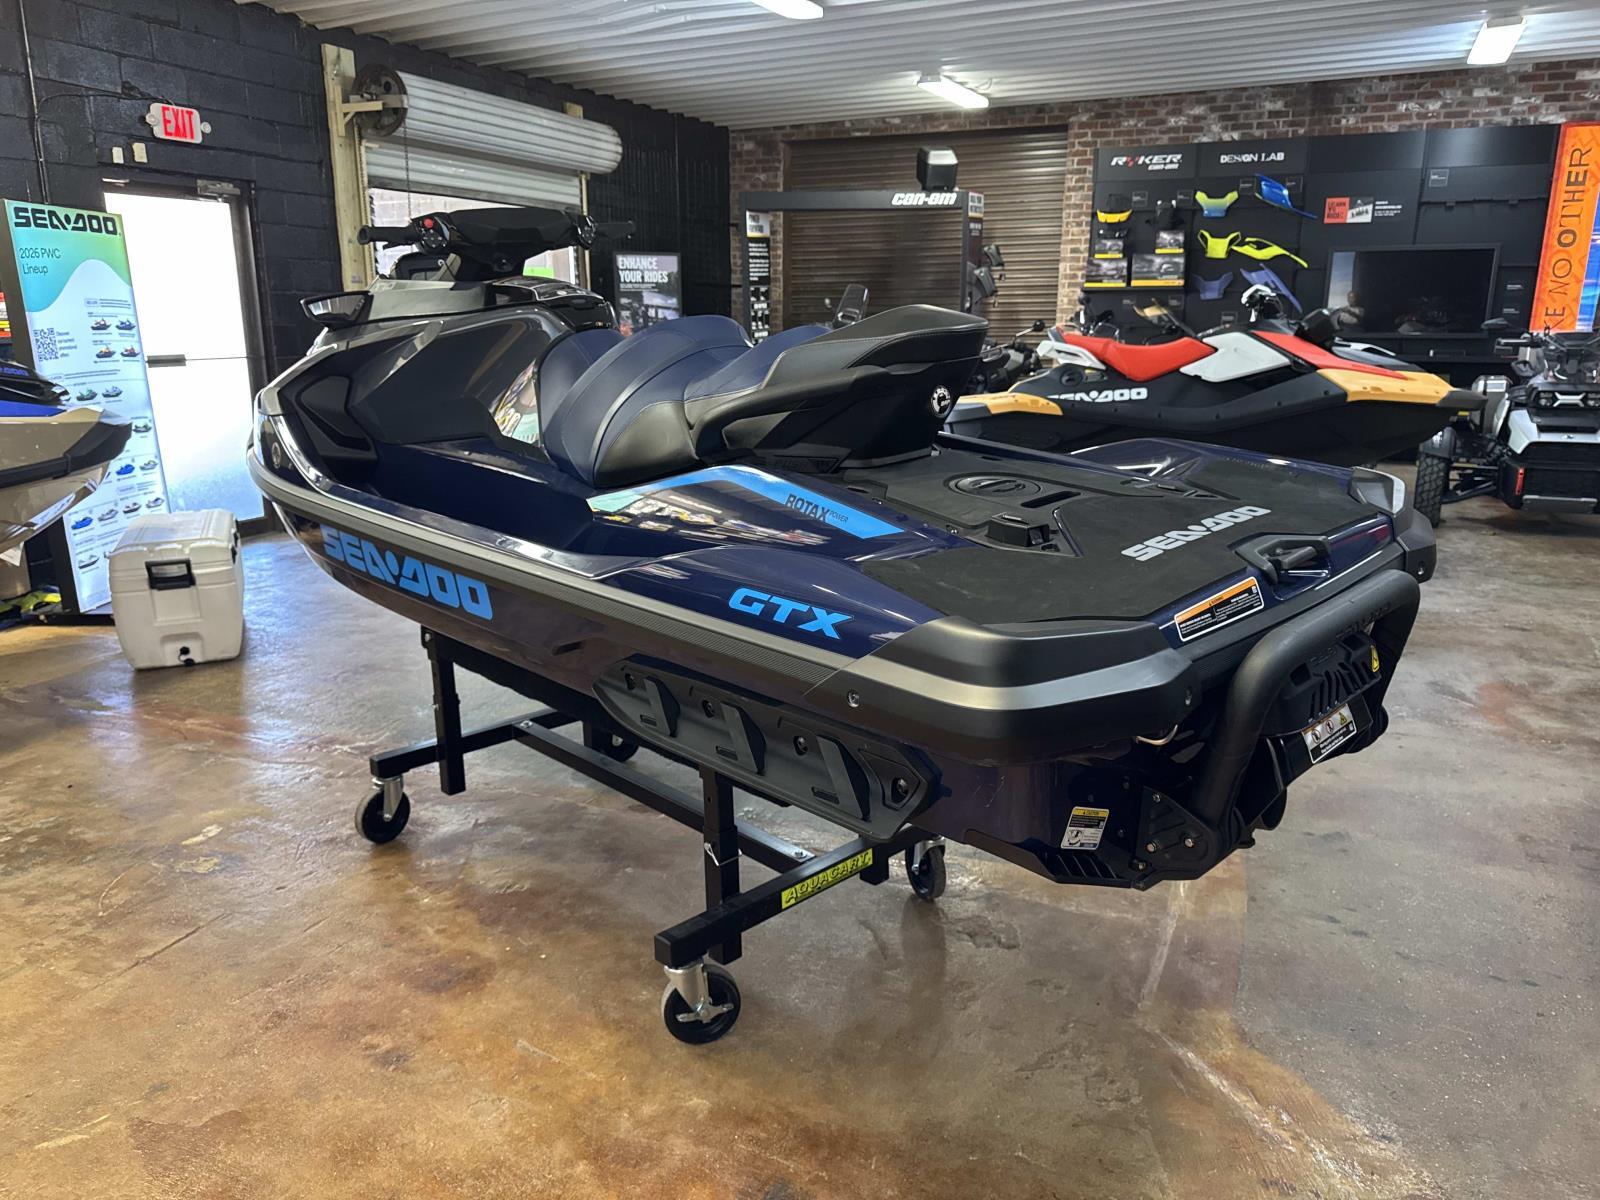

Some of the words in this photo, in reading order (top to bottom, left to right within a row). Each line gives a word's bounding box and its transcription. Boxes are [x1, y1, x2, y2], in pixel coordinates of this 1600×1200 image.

[161, 105, 195, 140] EXIT
[1111, 153, 1182, 168] RYKER
[1220, 154, 1258, 164] DESIGN
[1261, 152, 1285, 162] LAB
[1556, 147, 1593, 248] OTHER
[19, 247, 40, 259] 2026
[41, 248, 61, 259] PWC
[619, 256, 658, 269] ENHANCE
[22, 264, 48, 276] Lineup
[619, 270, 642, 283] YOUR
[644, 270, 669, 283] RIDES
[1548, 258, 1572, 296] NO
[785, 493, 830, 523] ROTAX
[829, 510, 849, 523] POWER
[728, 587, 853, 640] GTX
[785, 851, 869, 904] AQUACART
